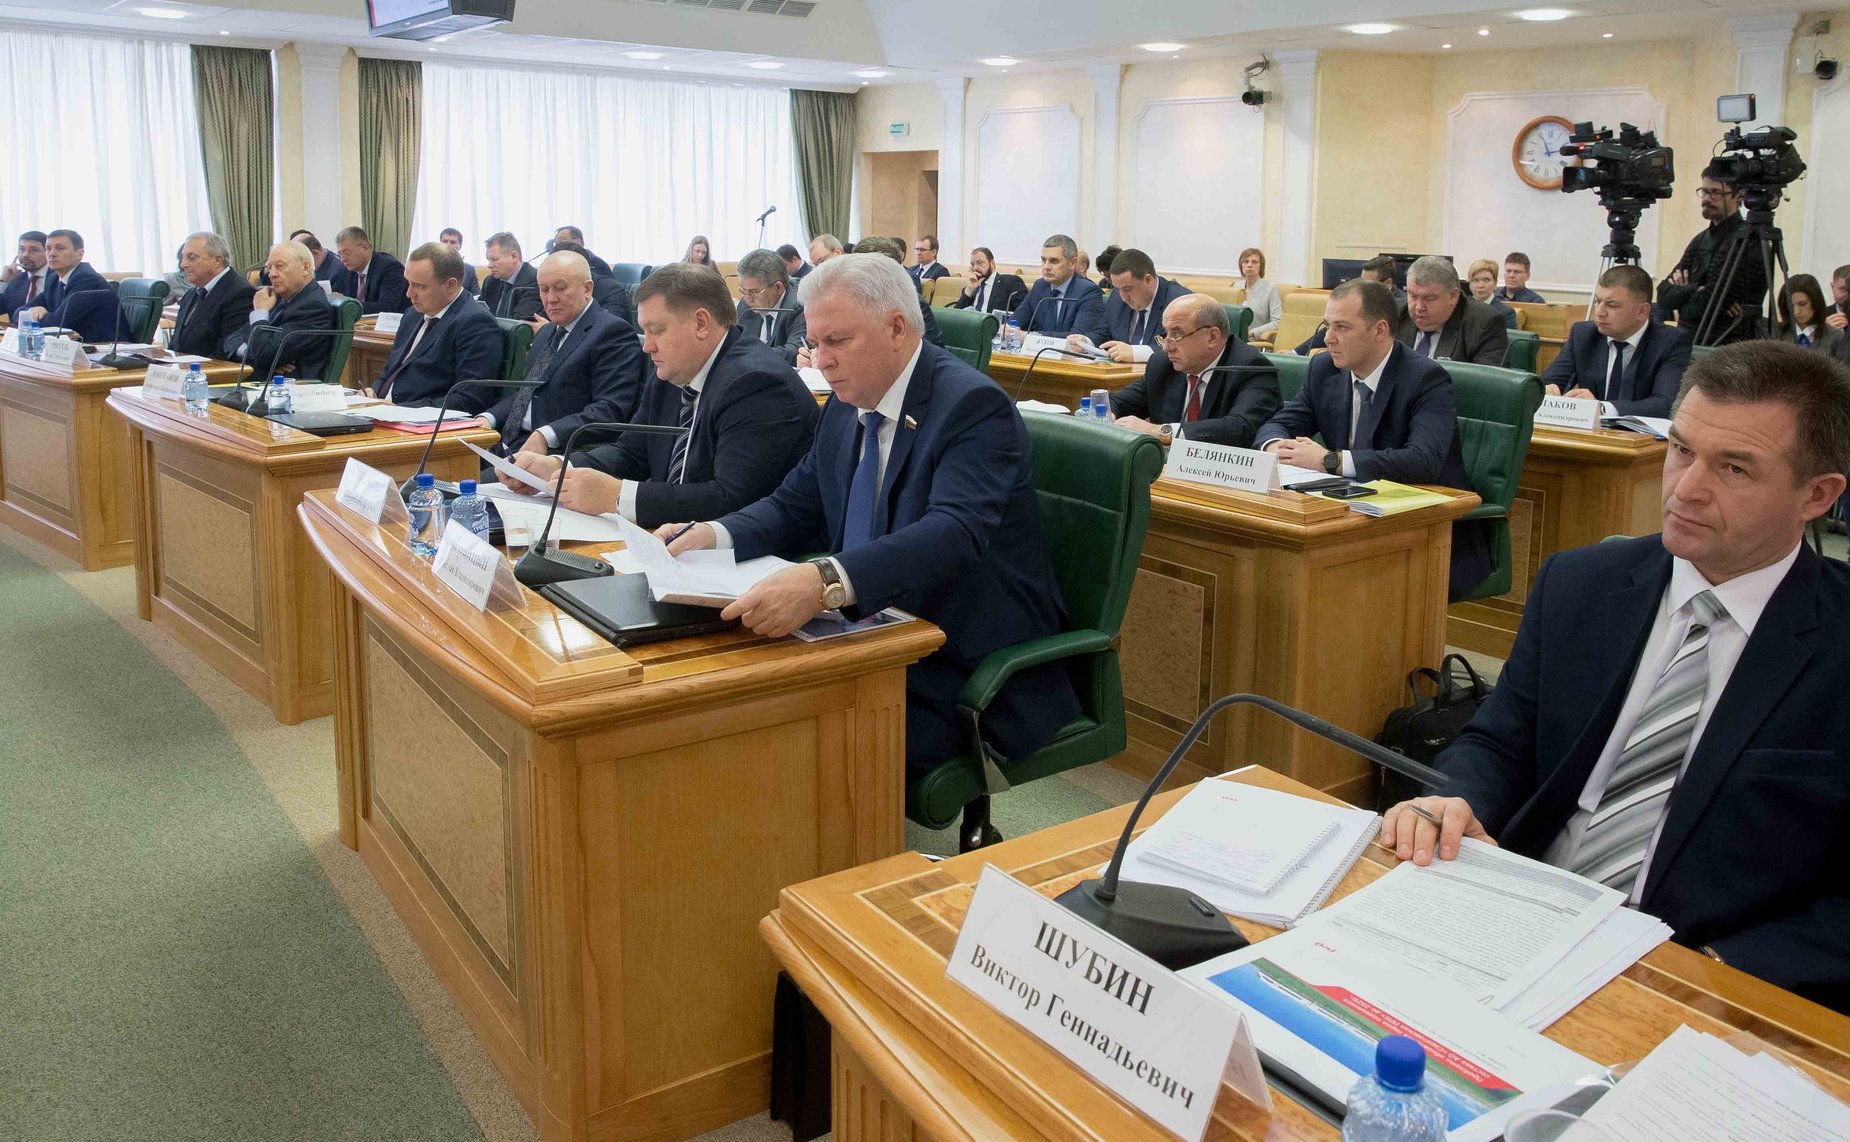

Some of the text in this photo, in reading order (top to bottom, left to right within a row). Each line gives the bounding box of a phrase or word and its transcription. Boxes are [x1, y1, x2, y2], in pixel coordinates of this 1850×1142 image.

[1177, 464, 1256, 485] Алексей Юрьевич
[1186, 447, 1254, 467] БЕЛЯНКИН
[1033, 920, 1156, 1016] ШУБИН
[970, 944, 1195, 1110] Виктор Геннадьевич
